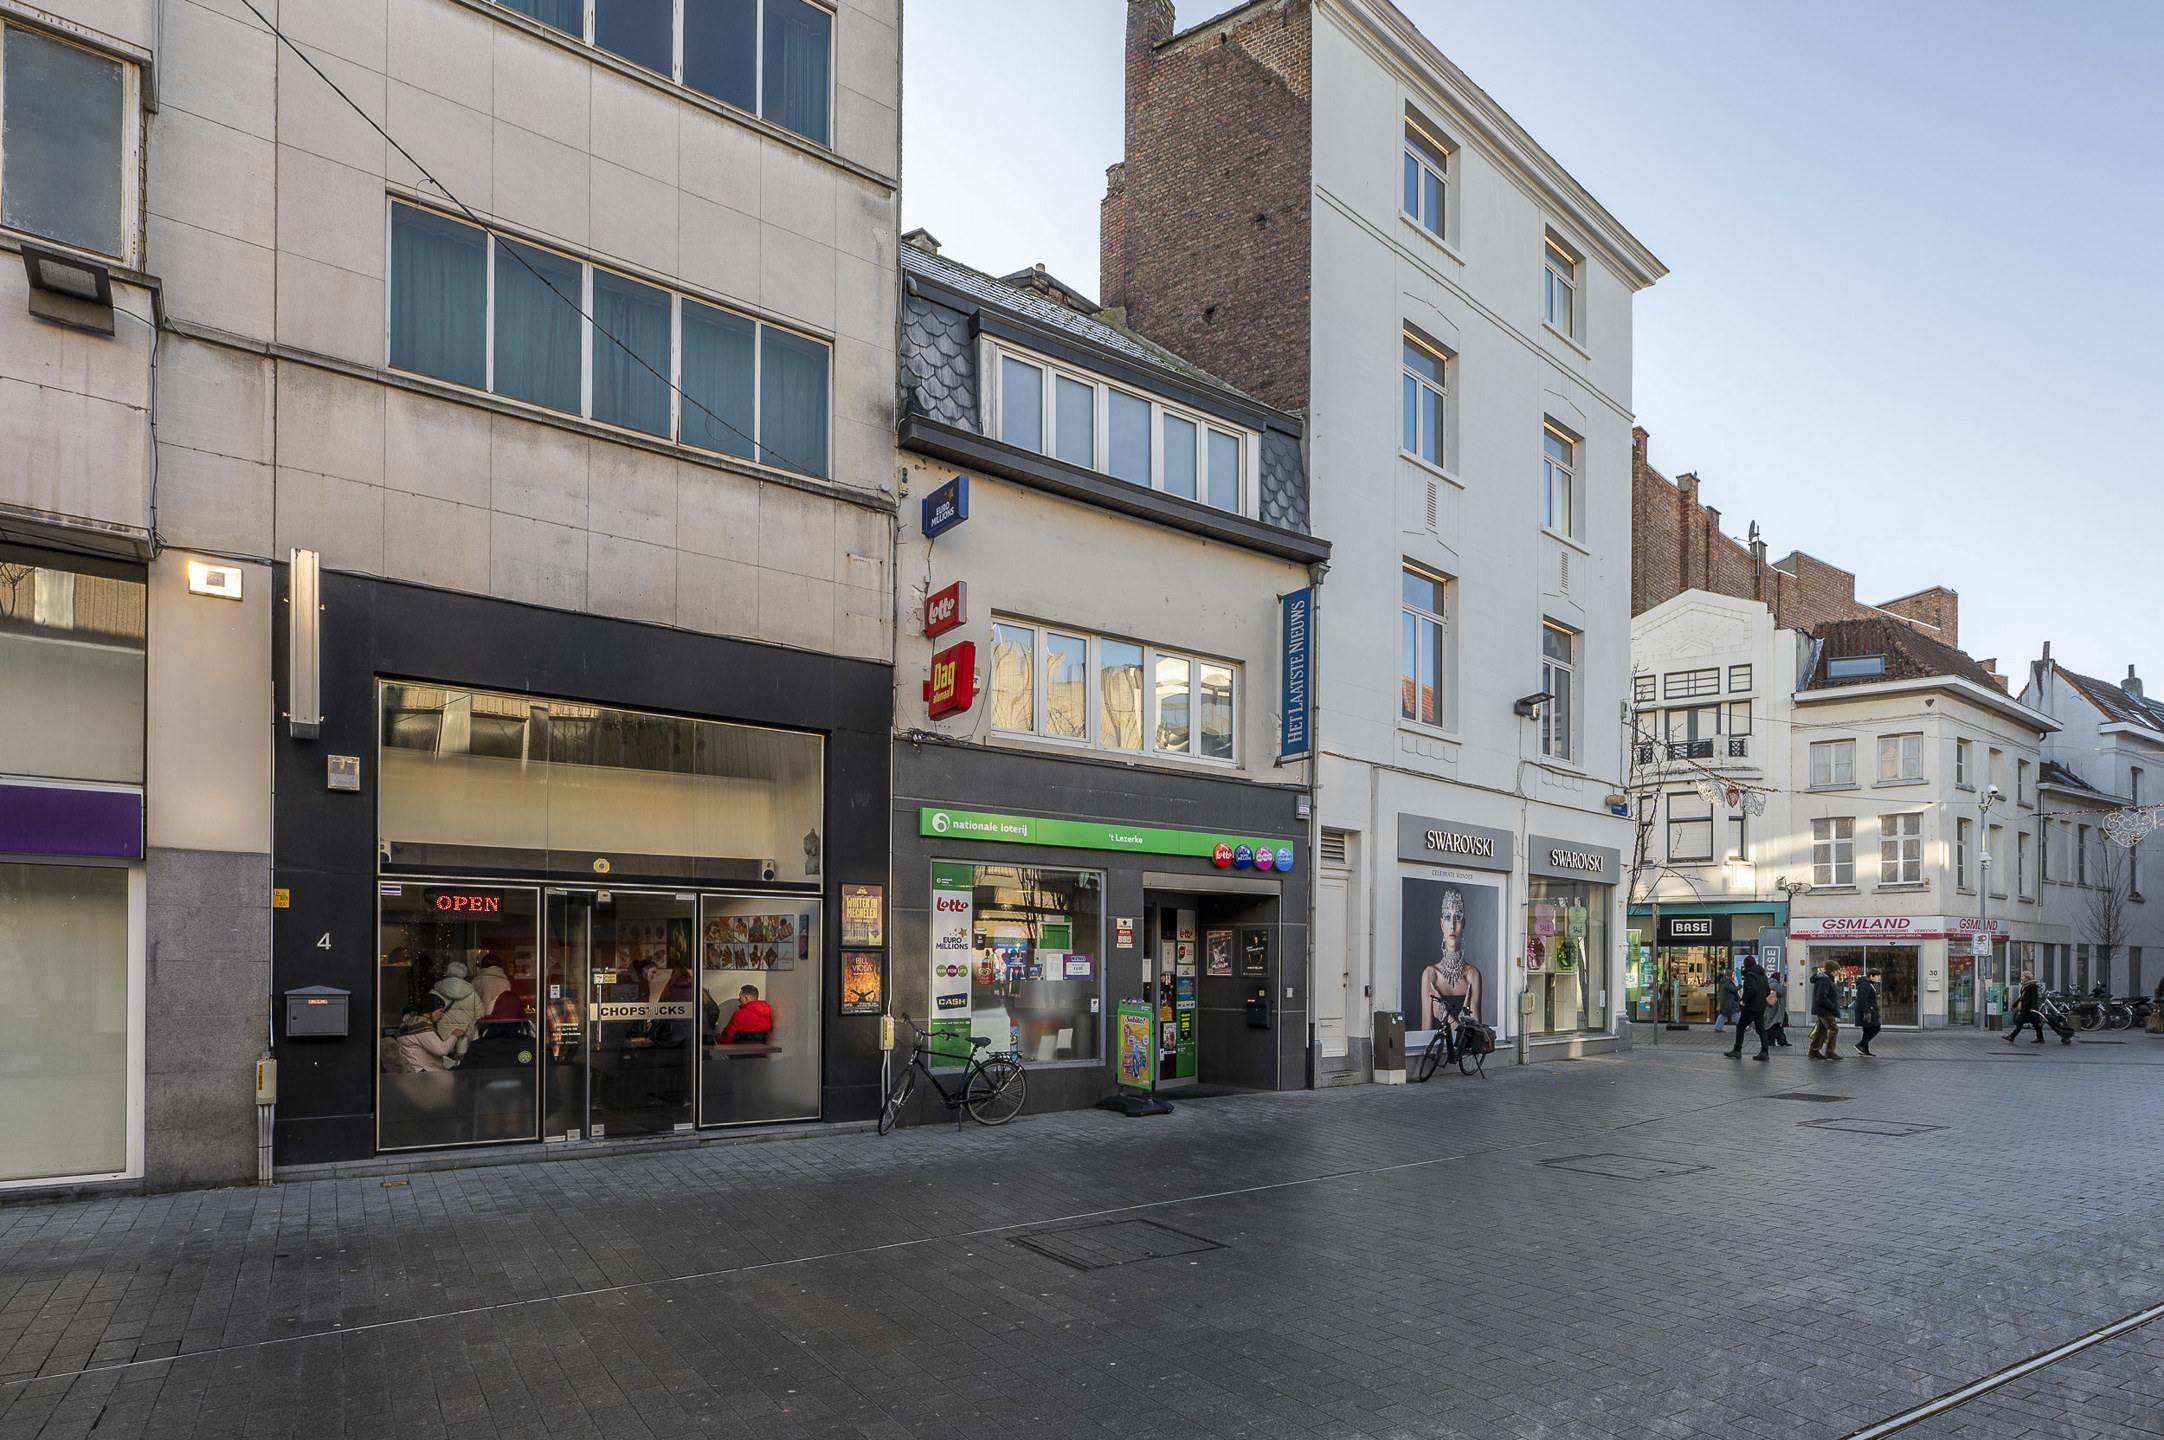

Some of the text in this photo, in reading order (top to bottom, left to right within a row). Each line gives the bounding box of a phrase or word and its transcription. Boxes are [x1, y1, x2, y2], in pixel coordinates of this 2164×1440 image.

[931, 506, 954, 527] MILLIONS
[936, 501, 950, 516] EURO
[934, 661, 955, 697] Dag
[1288, 600, 1305, 744] HET LAATSTE NIEUWS
[953, 820, 1028, 837] nationale loterij
[1115, 832, 1143, 844] Lezerke
[1427, 830, 1495, 857] SWAROVSKI
[1551, 848, 1604, 872] SWAROVSKI
[1431, 869, 1473, 880] CELEBRATE WONDER
[436, 895, 500, 912] OPEN
[847, 897, 870, 908] WINTER
[847, 908, 877, 918] MECHELEN
[1675, 923, 1708, 932] BASE
[1822, 918, 1910, 929] GSMLAND
[1959, 919, 1998, 930] GSMLND
[316, 932, 332, 950] 4
